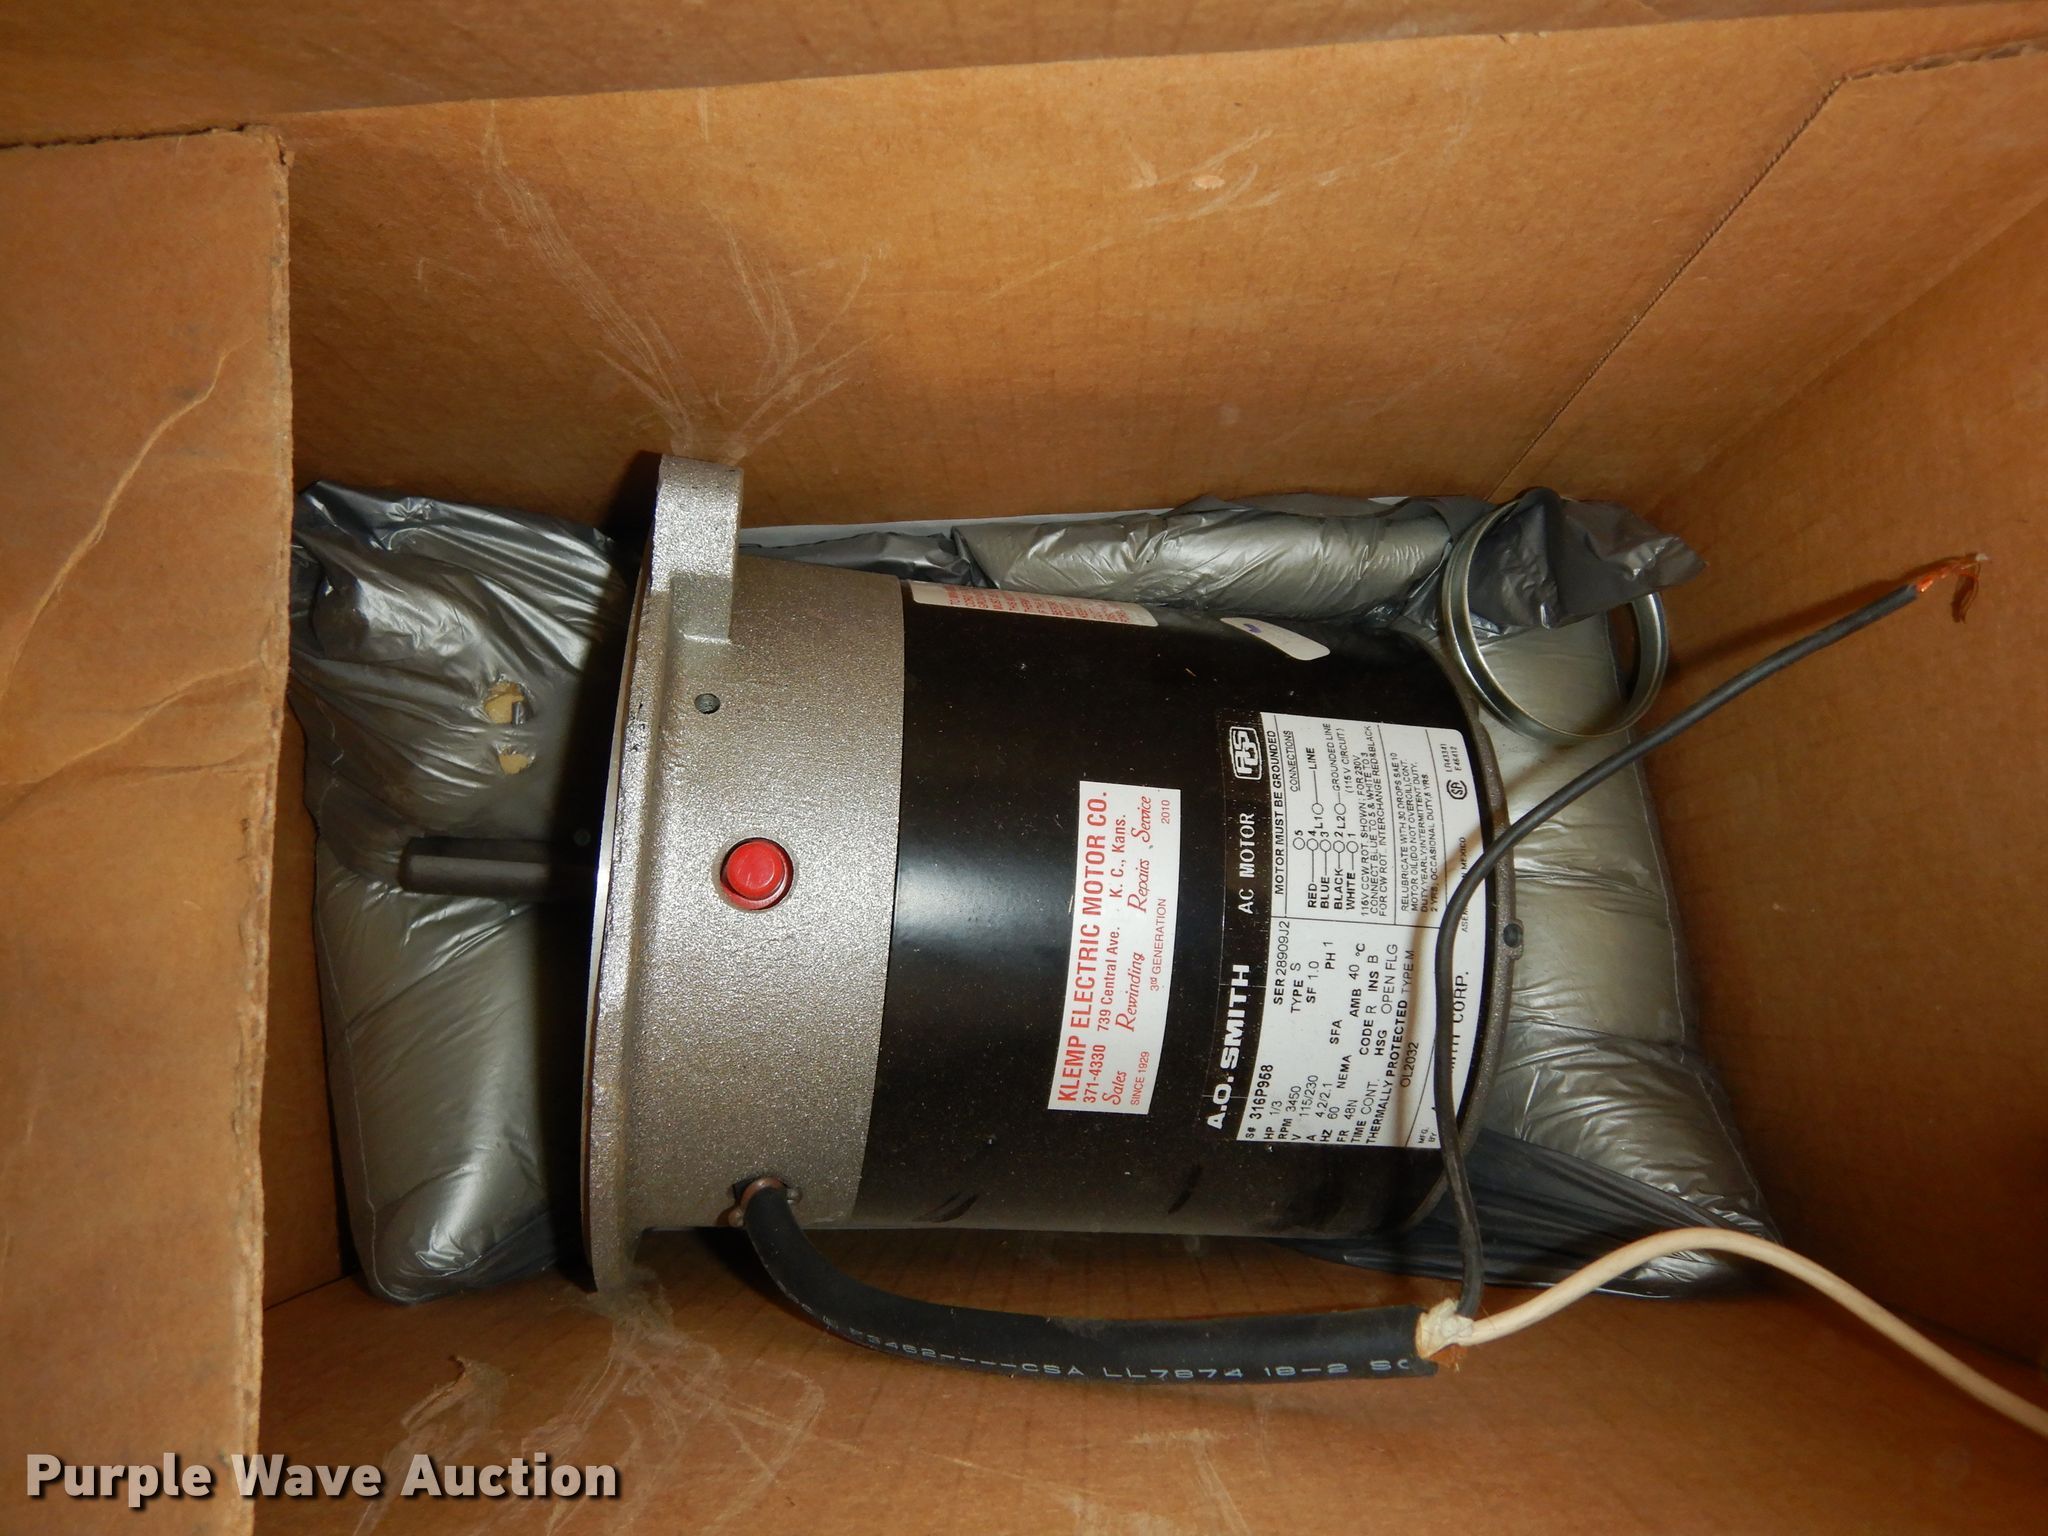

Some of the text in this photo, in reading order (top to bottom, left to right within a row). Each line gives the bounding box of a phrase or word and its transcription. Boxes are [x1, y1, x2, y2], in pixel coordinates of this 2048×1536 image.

[1322, 722, 1334, 740] LINE
[1283, 730, 1300, 792] CONNECTIONS
[1306, 747, 1318, 769] LINE
[1326, 741, 1341, 791] GROUNDED
[1362, 758, 1370, 770] TO
[1392, 762, 1401, 777] SAE
[1356, 777, 1364, 795] FOR
[1364, 772, 1374, 800] WHITE
[1394, 780, 1404, 808] DROPS
[1422, 774, 1430, 789] YRS
[1267, 730, 1284, 894] MOTOR MUST BE GROUNDED
[1368, 819, 1377, 832] TO
[1374, 778, 1387, 846] INTERCHANGE
[1398, 811, 1406, 820] 30
[1112, 814, 1126, 853] Kans.
[1239, 812, 1255, 877] MOTOR
[1370, 834, 1378, 861] BLUE
[1399, 822, 1408, 844] WITH
[1408, 824, 1417, 843] NOT
[1428, 823, 1438, 880] OCCASIONAL
[1458, 836, 1468, 870] MEXICO
[1110, 884, 1123, 898] K.
[1308, 883, 1318, 908] RED
[1320, 876, 1330, 908] BLUE
[1334, 868, 1343, 909] BLACK
[1346, 872, 1356, 910] WHITE
[1360, 865, 1370, 890] CCW
[1370, 863, 1378, 914] CONNECT
[1380, 876, 1388, 892] CW
[1400, 846, 1410, 911] RELUBRICATE
[1410, 877, 1419, 911] MOTOR
[1238, 888, 1254, 914] AC
[1380, 895, 1388, 916] FOR
[1058, 791, 1107, 1101] KLEMP ELECTRIC MOTOR CO.
[1102, 795, 1152, 1105] Sales Rewinding Repairs Service
[1106, 927, 1120, 954] Ave.
[1130, 1076, 1144, 1105] SINCE
[1138, 1051, 1150, 1073] 1929
[1152, 898, 1166, 974] GENERATION
[1161, 799, 1170, 824] 2010
[1273, 920, 1290, 1005] SER 28909J2
[1325, 952, 1336, 969] PH
[1348, 964, 1360, 979] 40
[1101, 959, 1116, 1005] Central
[1290, 962, 1304, 1013] TYPE S
[1306, 960, 1320, 1003] SF 1.0
[1374, 944, 1398, 1055] HSG OPEN FLG
[1452, 971, 1469, 1023] CORP.
[1098, 1009, 1111, 1031] 739
[1220, 964, 1250, 1069] SMITH
[1350, 988, 1362, 1017] AMB
[1359, 954, 1380, 1055] CODE R INS B
[1329, 1019, 1342, 1044] SFA
[1366, 949, 1414, 1144] THERMALLY PROTECTED TYPE M
[1083, 1044, 1106, 1103] 371-4330
[1336, 1055, 1352, 1089] NEMA
[1400, 1041, 1419, 1087] OL2032
[1207, 1076, 1234, 1129] A.O.
[1278, 1085, 1301, 1140] RPM 3450
[1299, 1074, 1318, 1116] 115/230
[1315, 1082, 1332, 1117] 4.2/2.1
[1350, 1078, 1380, 1143] TIME CONT.
[1264, 1100, 1282, 1139] HP 1/3
[1320, 1106, 1340, 1142] HZ 60
[1336, 1099, 1358, 1142] FR 48N
